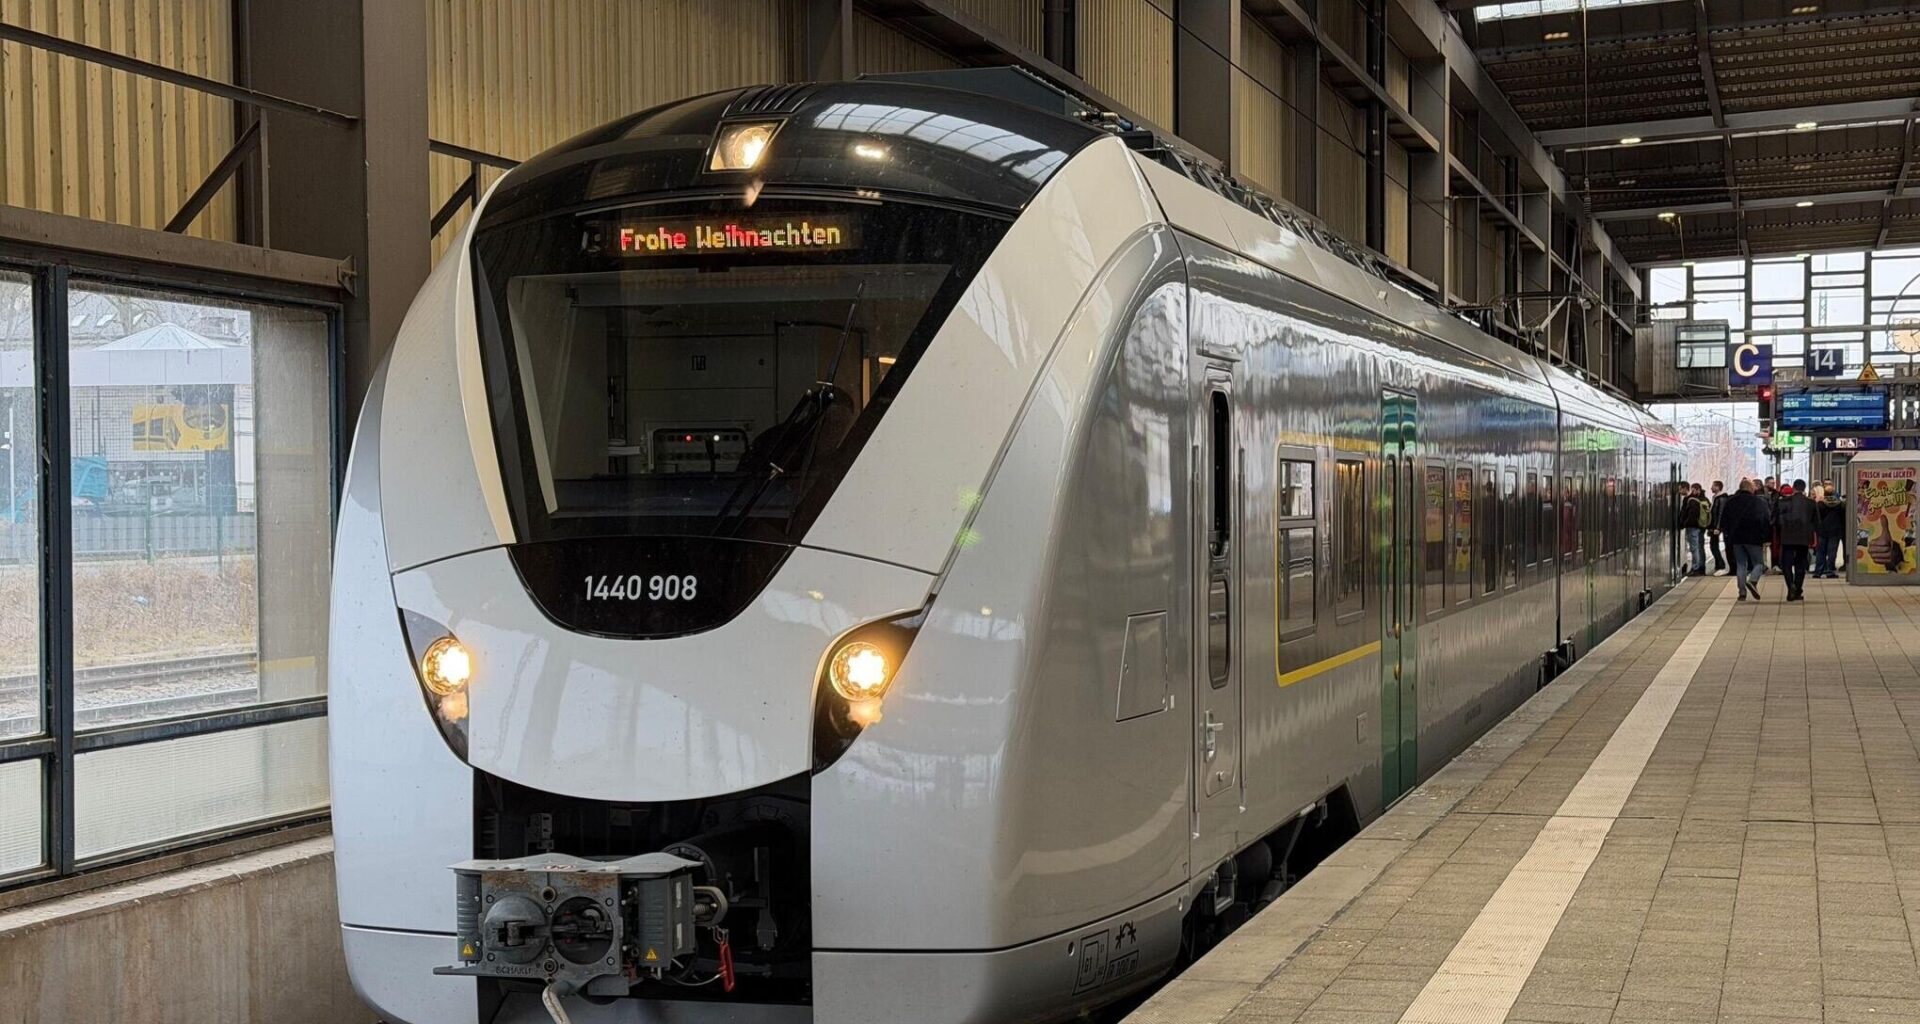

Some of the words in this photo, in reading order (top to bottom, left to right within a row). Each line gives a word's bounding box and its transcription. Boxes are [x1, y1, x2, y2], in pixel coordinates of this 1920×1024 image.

[620, 227, 688, 251] Frohe
[696, 222, 841, 249] Weihnachten
[1734, 343, 1760, 377] C
[1809, 349, 1836, 371] 14
[584, 575, 642, 601] 1440
[648, 575, 698, 601] 908
